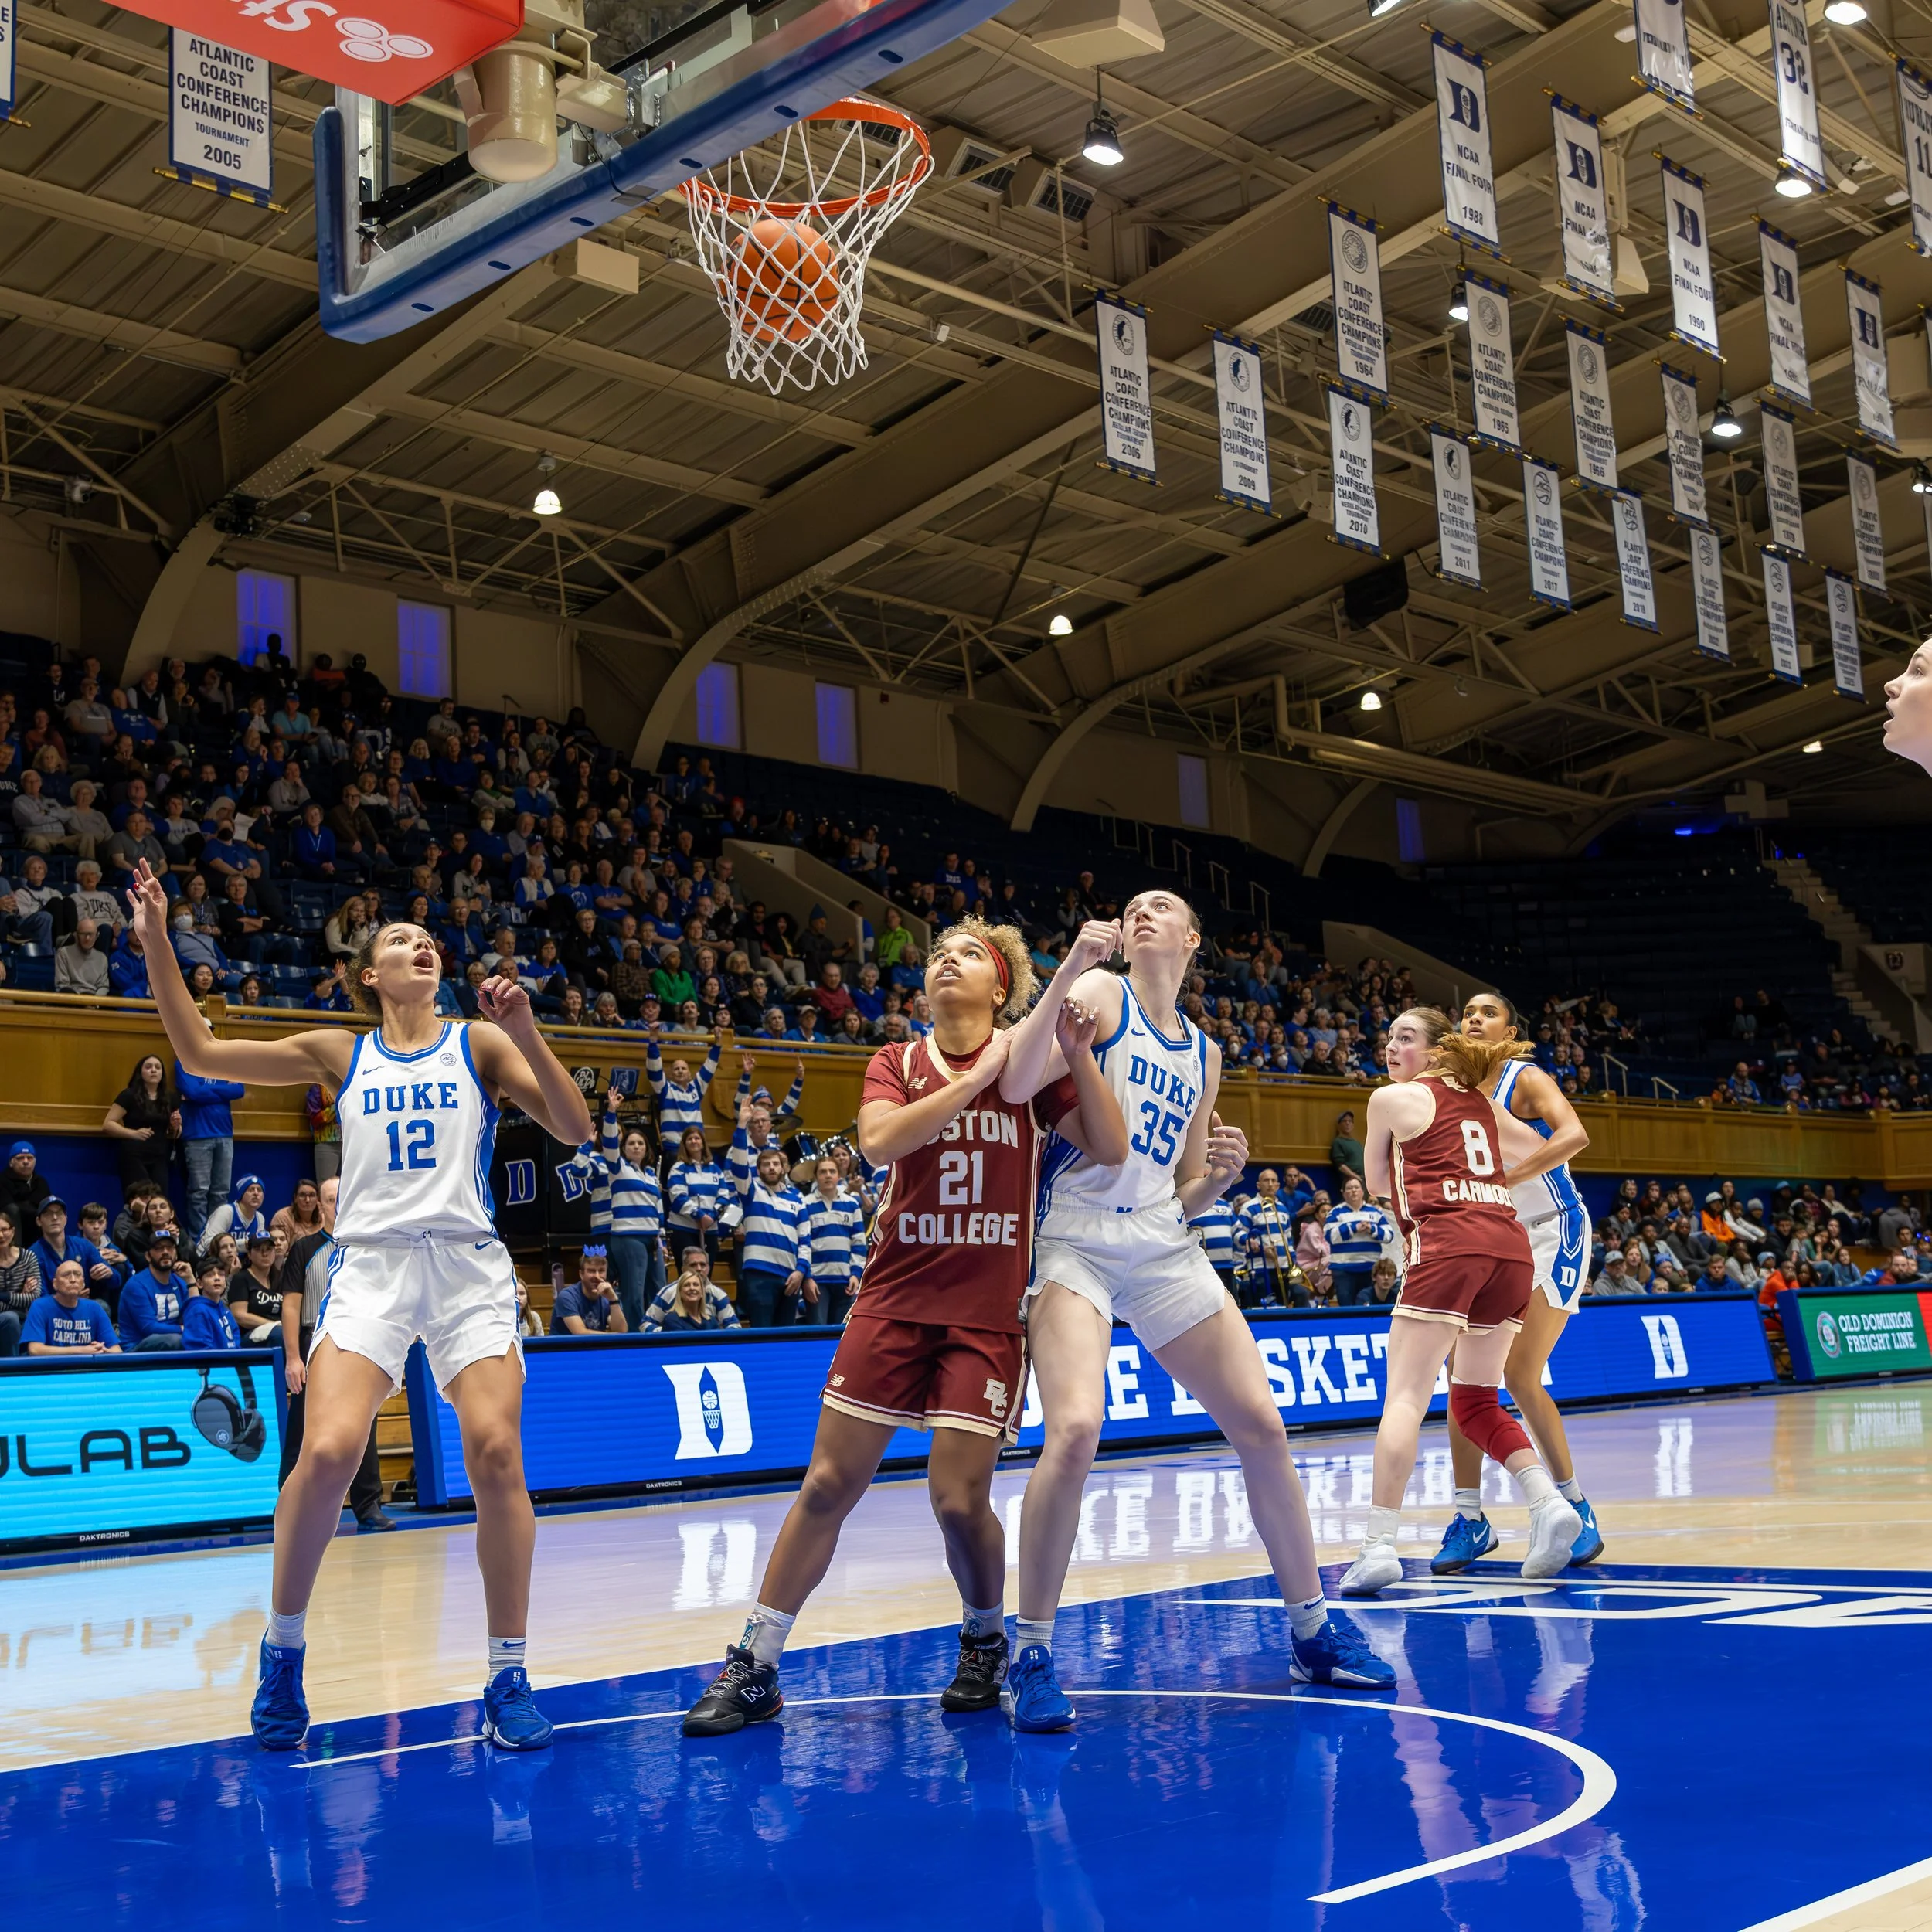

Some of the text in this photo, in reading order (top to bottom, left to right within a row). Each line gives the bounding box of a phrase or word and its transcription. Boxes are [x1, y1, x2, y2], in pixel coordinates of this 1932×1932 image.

[189, 38, 254, 72] ATLANTIC
[200, 62, 244, 88] COAST
[1780, 42, 1808, 95] 32
[177, 73, 267, 116] CONFERENCE
[181, 94, 264, 134] CHAMPIONS
[195, 121, 250, 148] TOURNAMENT
[203, 145, 241, 170] 2005
[1457, 144, 1480, 165] NCAA
[1446, 162, 1471, 183] FINAL
[1462, 206, 1483, 226] 1988
[1575, 201, 1596, 220] NCAA
[1683, 258, 1700, 277] NCAA
[1343, 281, 1373, 303] ATLANTIC
[1675, 274, 1693, 294] FINAL
[1348, 297, 1370, 315] COAST
[1338, 307, 1382, 336] CONFERENCE
[1689, 314, 1705, 331] 1990
[1342, 323, 1382, 350] CHAMPIONS
[1478, 343, 1506, 363] ATLANTIC
[1110, 365, 1141, 386] ATLANTIC
[1355, 361, 1374, 378] 1964
[1484, 359, 1504, 376] COAST
[1115, 382, 1138, 399] COAST
[1475, 369, 1515, 393] CONFERENCE
[1105, 391, 1151, 418] CONFERENCE
[1478, 384, 1515, 406] CHAMPIONS
[1108, 406, 1151, 431] CHAMPIONS
[1226, 401, 1258, 421] ATLANTIC
[1233, 416, 1253, 433] COAST
[1577, 414, 1614, 437] CONFERENCE
[1222, 427, 1264, 451] CONFERENCE
[1579, 429, 1613, 451] CHAMPIONS
[1121, 443, 1141, 459] 2006
[1224, 442, 1264, 464] CHAMPIONS
[1339, 449, 1367, 468] ATLANTIC
[1346, 464, 1364, 479] COAST
[1335, 474, 1374, 497] CONFERENCE
[1338, 488, 1374, 509] CHAMPIONS
[1443, 488, 1468, 506] ATLANTIC
[1447, 502, 1465, 516] COAST
[1349, 519, 1368, 534] 2010
[1440, 512, 1476, 533] CONFERENCE
[1454, 556, 1470, 570] 2011
[1128, 1054, 1196, 1119] DUKE
[362, 1082, 458, 1116] DUKE
[927, 1110, 1019, 1148] STON
[1131, 1100, 1185, 1167] 35
[386, 1119, 437, 1172] 12
[1460, 1119, 1495, 1175] 8
[939, 1151, 984, 1206] 21
[1442, 1179, 1517, 1211] CARMOD
[898, 1212, 1019, 1246] COLLEGE
[1560, 1266, 1576, 1287] D
[257, 1290, 283, 1304] Duk
[63, 1319, 73, 1330] TO
[1838, 1311, 1913, 1332] OLD DOMINION
[53, 1329, 91, 1344] CAROLINA
[1845, 1332, 1917, 1353] FREIGHT LINE
[645, 1480, 682, 1489] DAKTRONICS
[79, 1531, 130, 1543] DAKTRONICS
